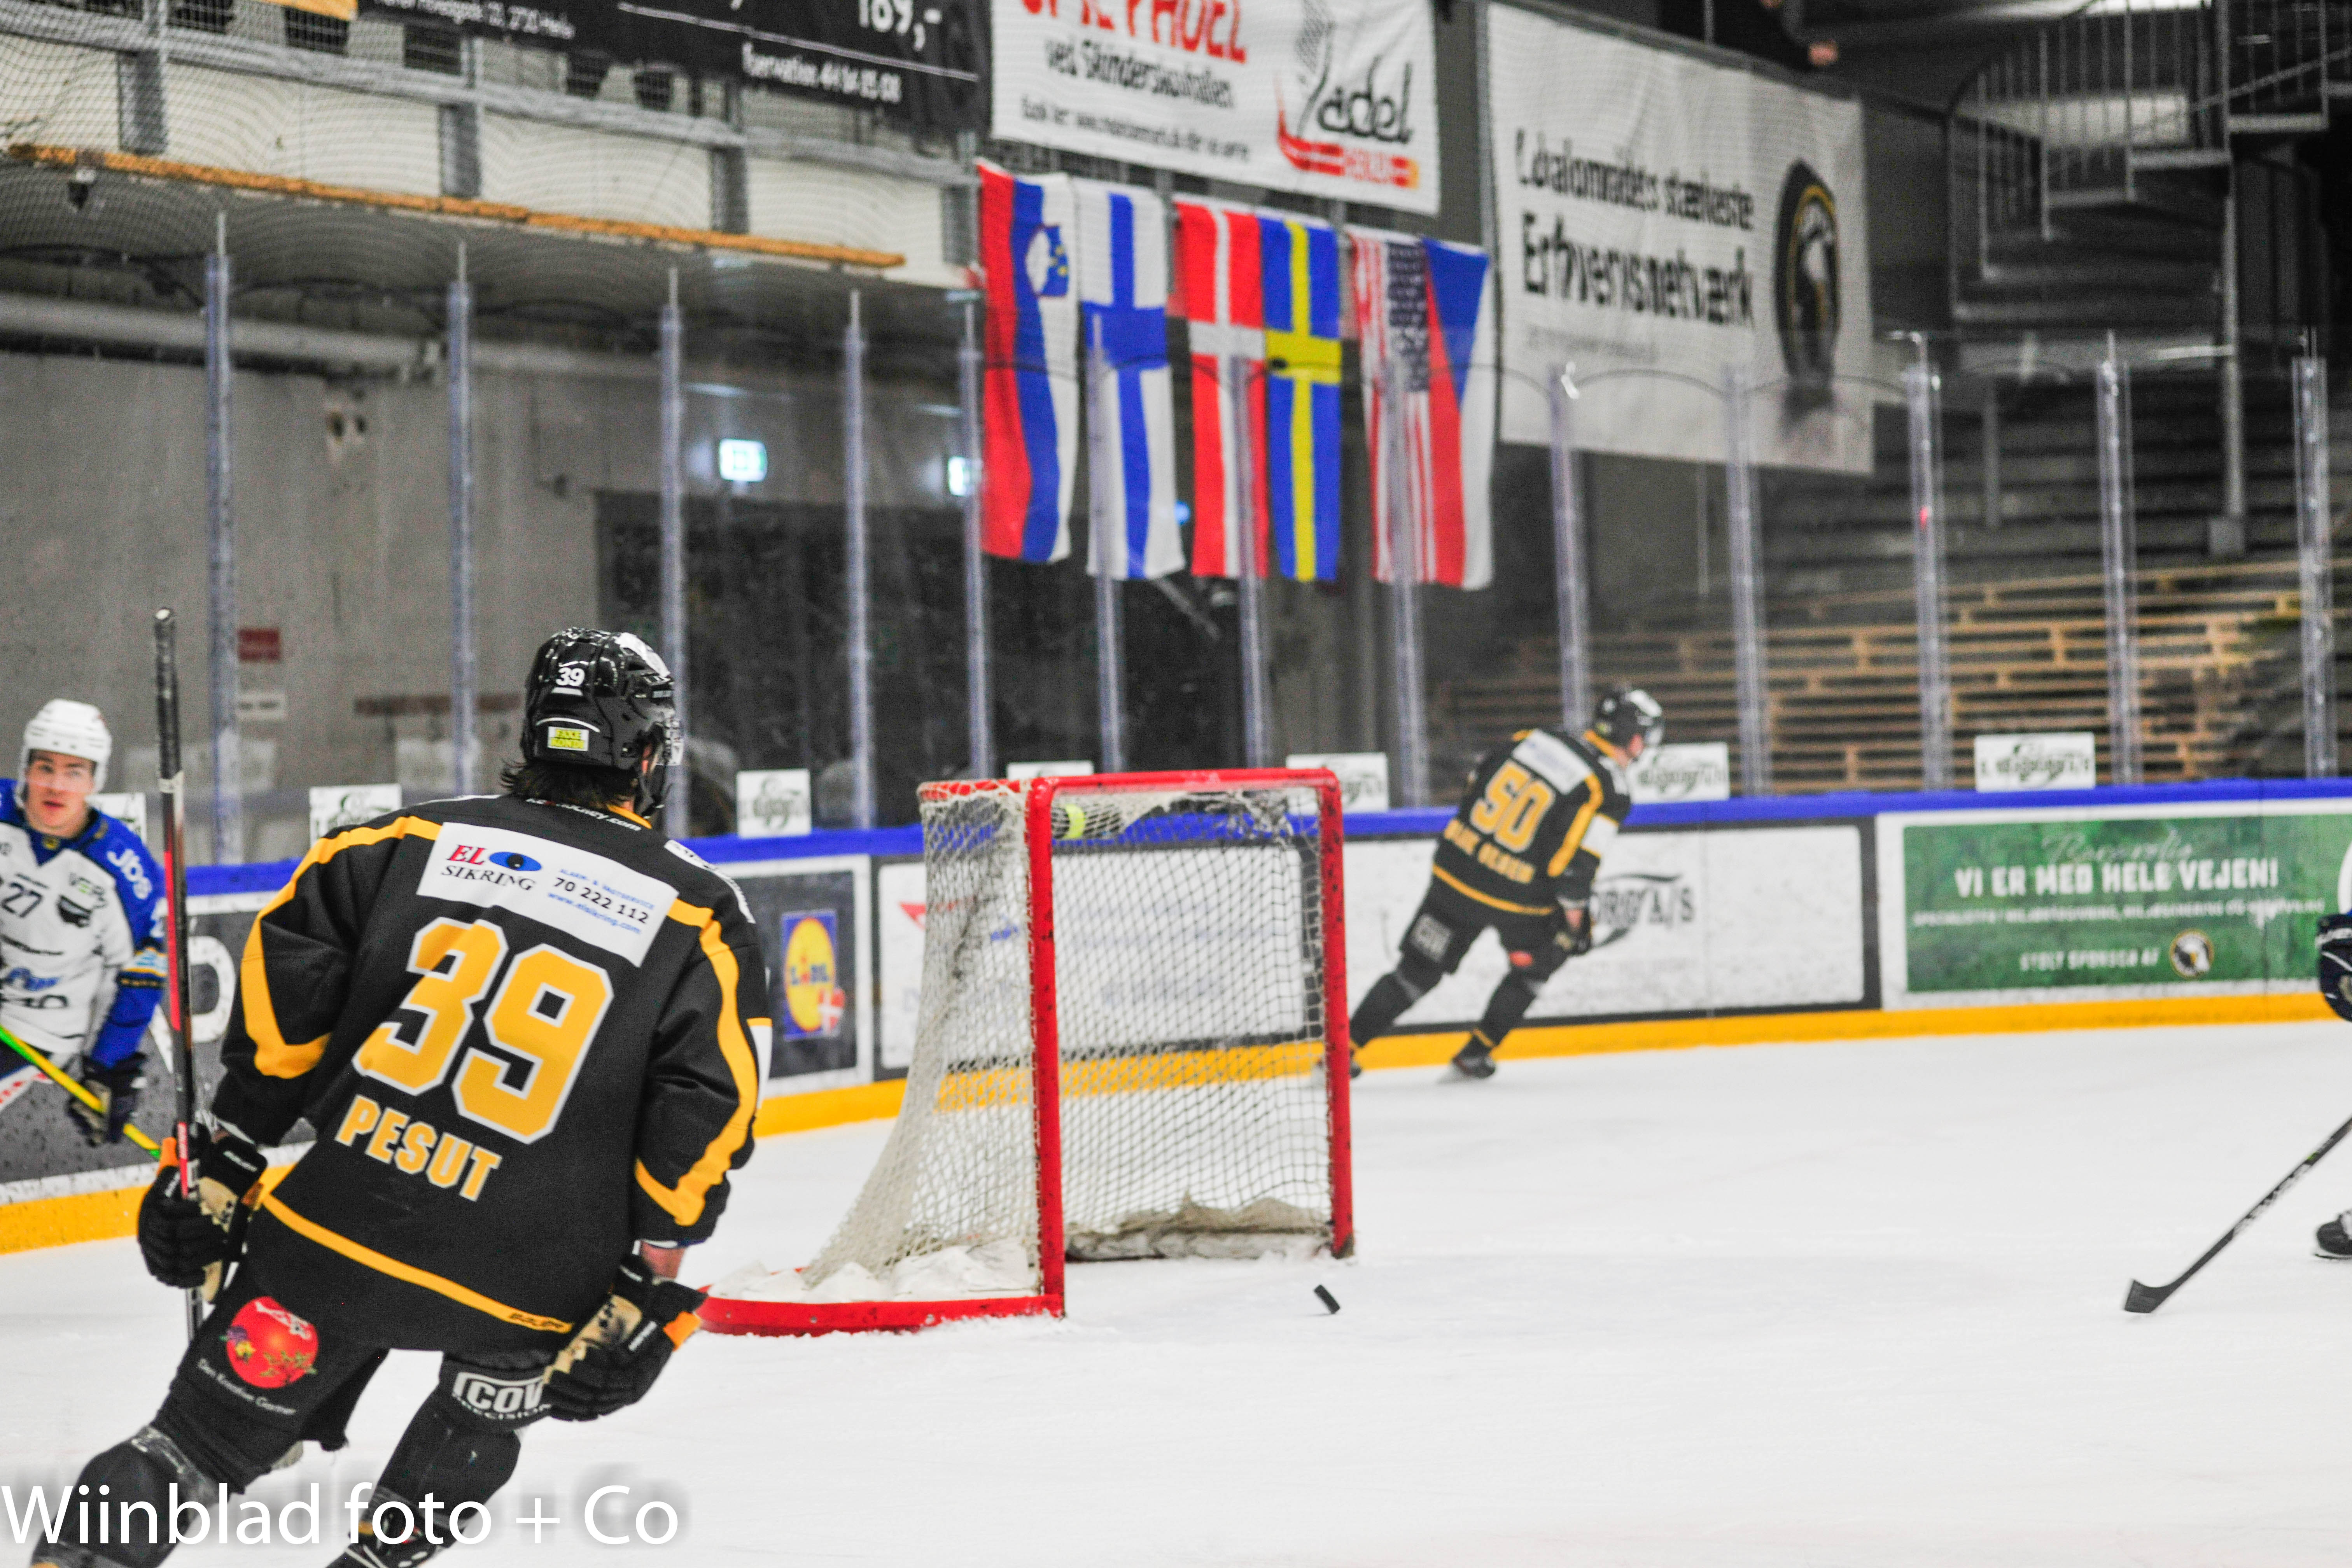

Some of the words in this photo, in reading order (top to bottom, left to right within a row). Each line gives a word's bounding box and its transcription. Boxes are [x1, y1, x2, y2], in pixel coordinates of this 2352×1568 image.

[555, 667, 586, 687] 39
[1470, 758, 1556, 852] 50
[447, 844, 489, 865] EL
[441, 865, 536, 891] SIKRING
[1, 882, 44, 918] 27
[554, 877, 575, 892] 70
[581, 887, 612, 909] 222
[617, 905, 649, 924] 112
[352, 916, 615, 1145] 39
[334, 1094, 503, 1202] PESUT
